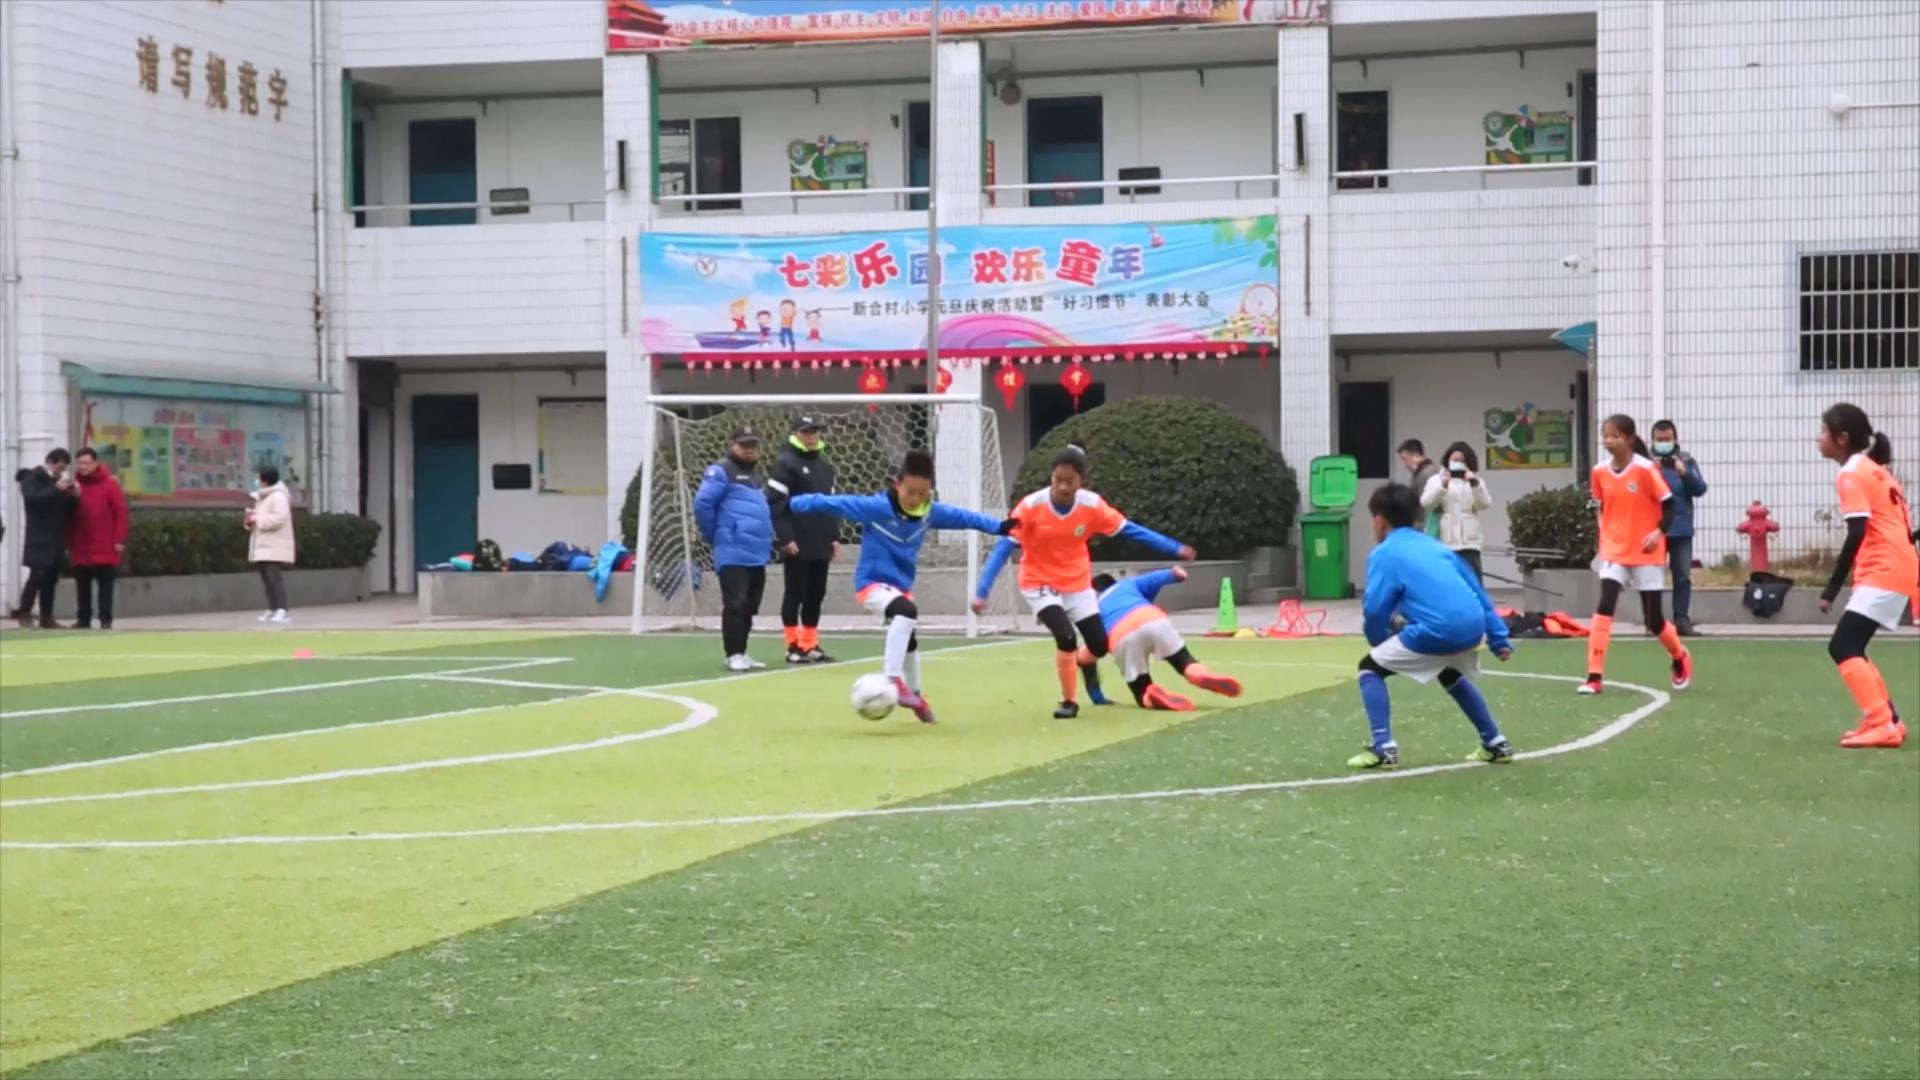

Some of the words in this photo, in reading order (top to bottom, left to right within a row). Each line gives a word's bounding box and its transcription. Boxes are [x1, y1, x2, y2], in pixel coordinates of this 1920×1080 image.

[136, 34, 288, 122] 请写规范字
[779, 241, 942, 289] 七彩乐园
[973, 240, 1143, 288] 欢乐童年
